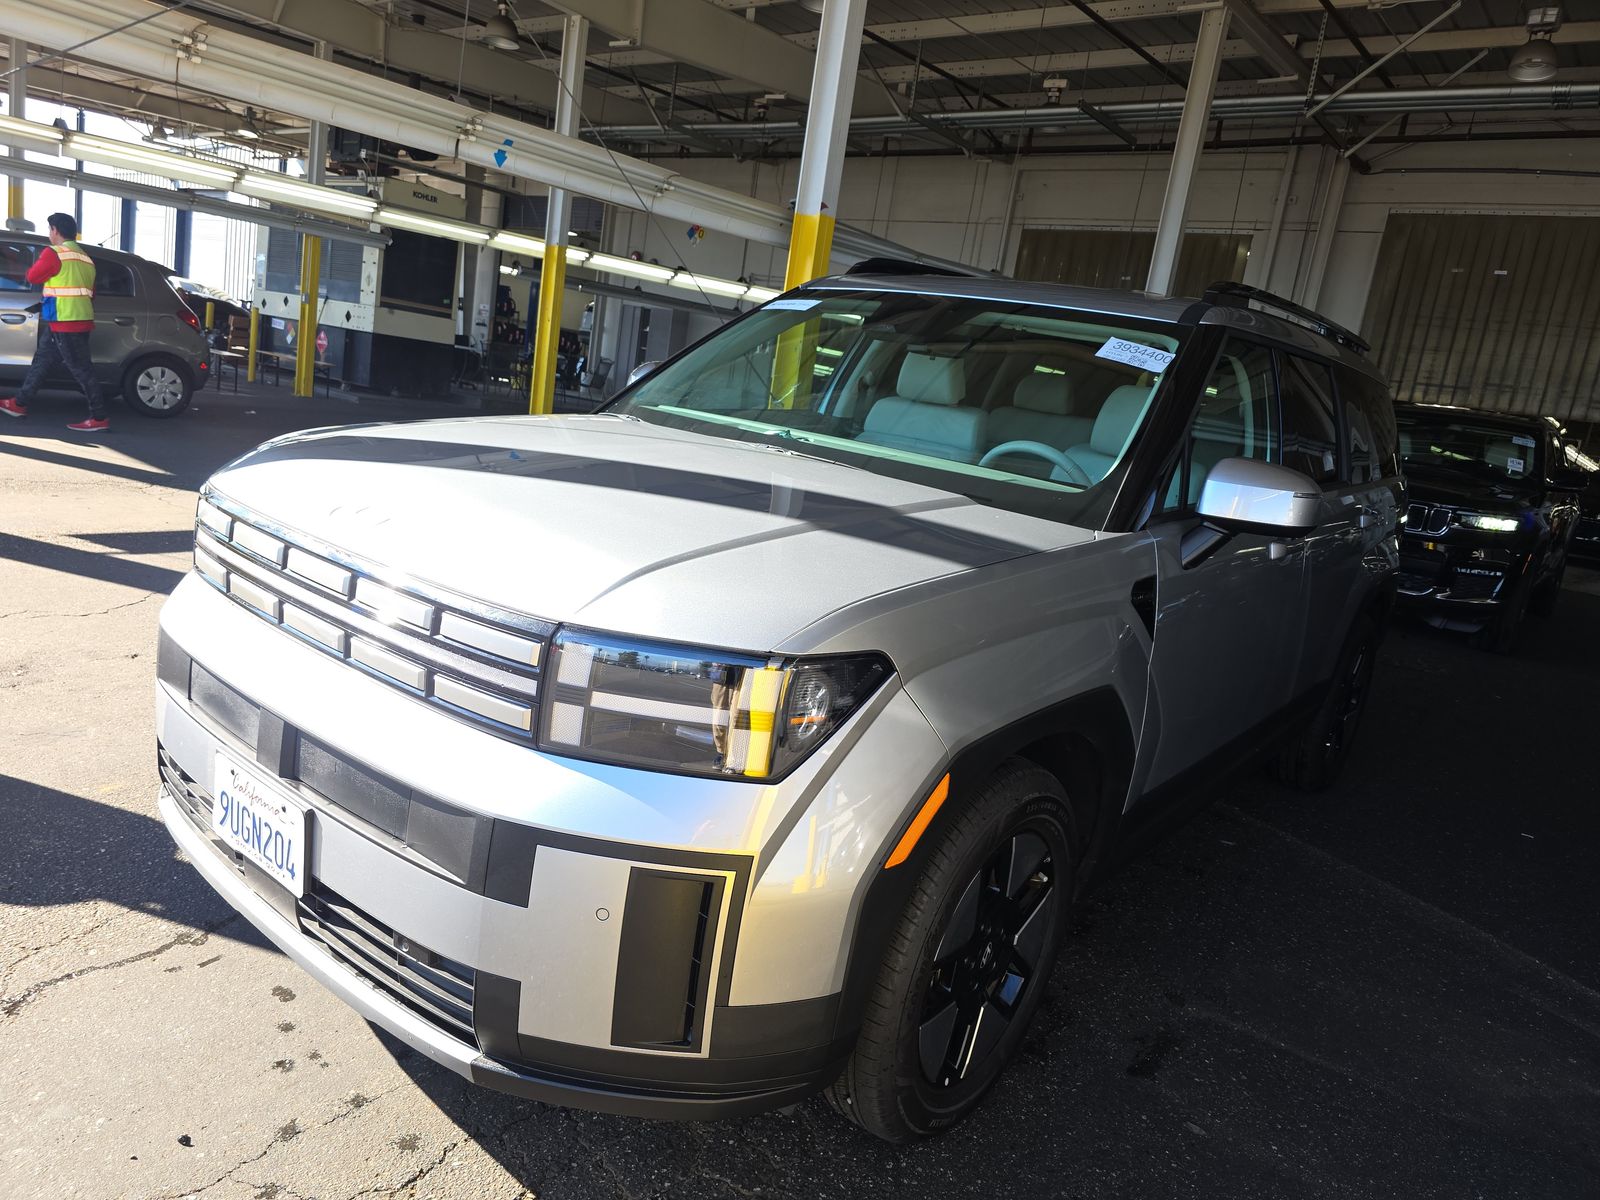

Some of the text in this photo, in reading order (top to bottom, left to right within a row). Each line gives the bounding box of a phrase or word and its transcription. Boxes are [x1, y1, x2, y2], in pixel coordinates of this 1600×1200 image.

[412, 191, 438, 203] KOHLER
[1112, 341, 1173, 364] 3934400
[232, 772, 280, 816] California
[219, 790, 296, 880] 9UGN204
